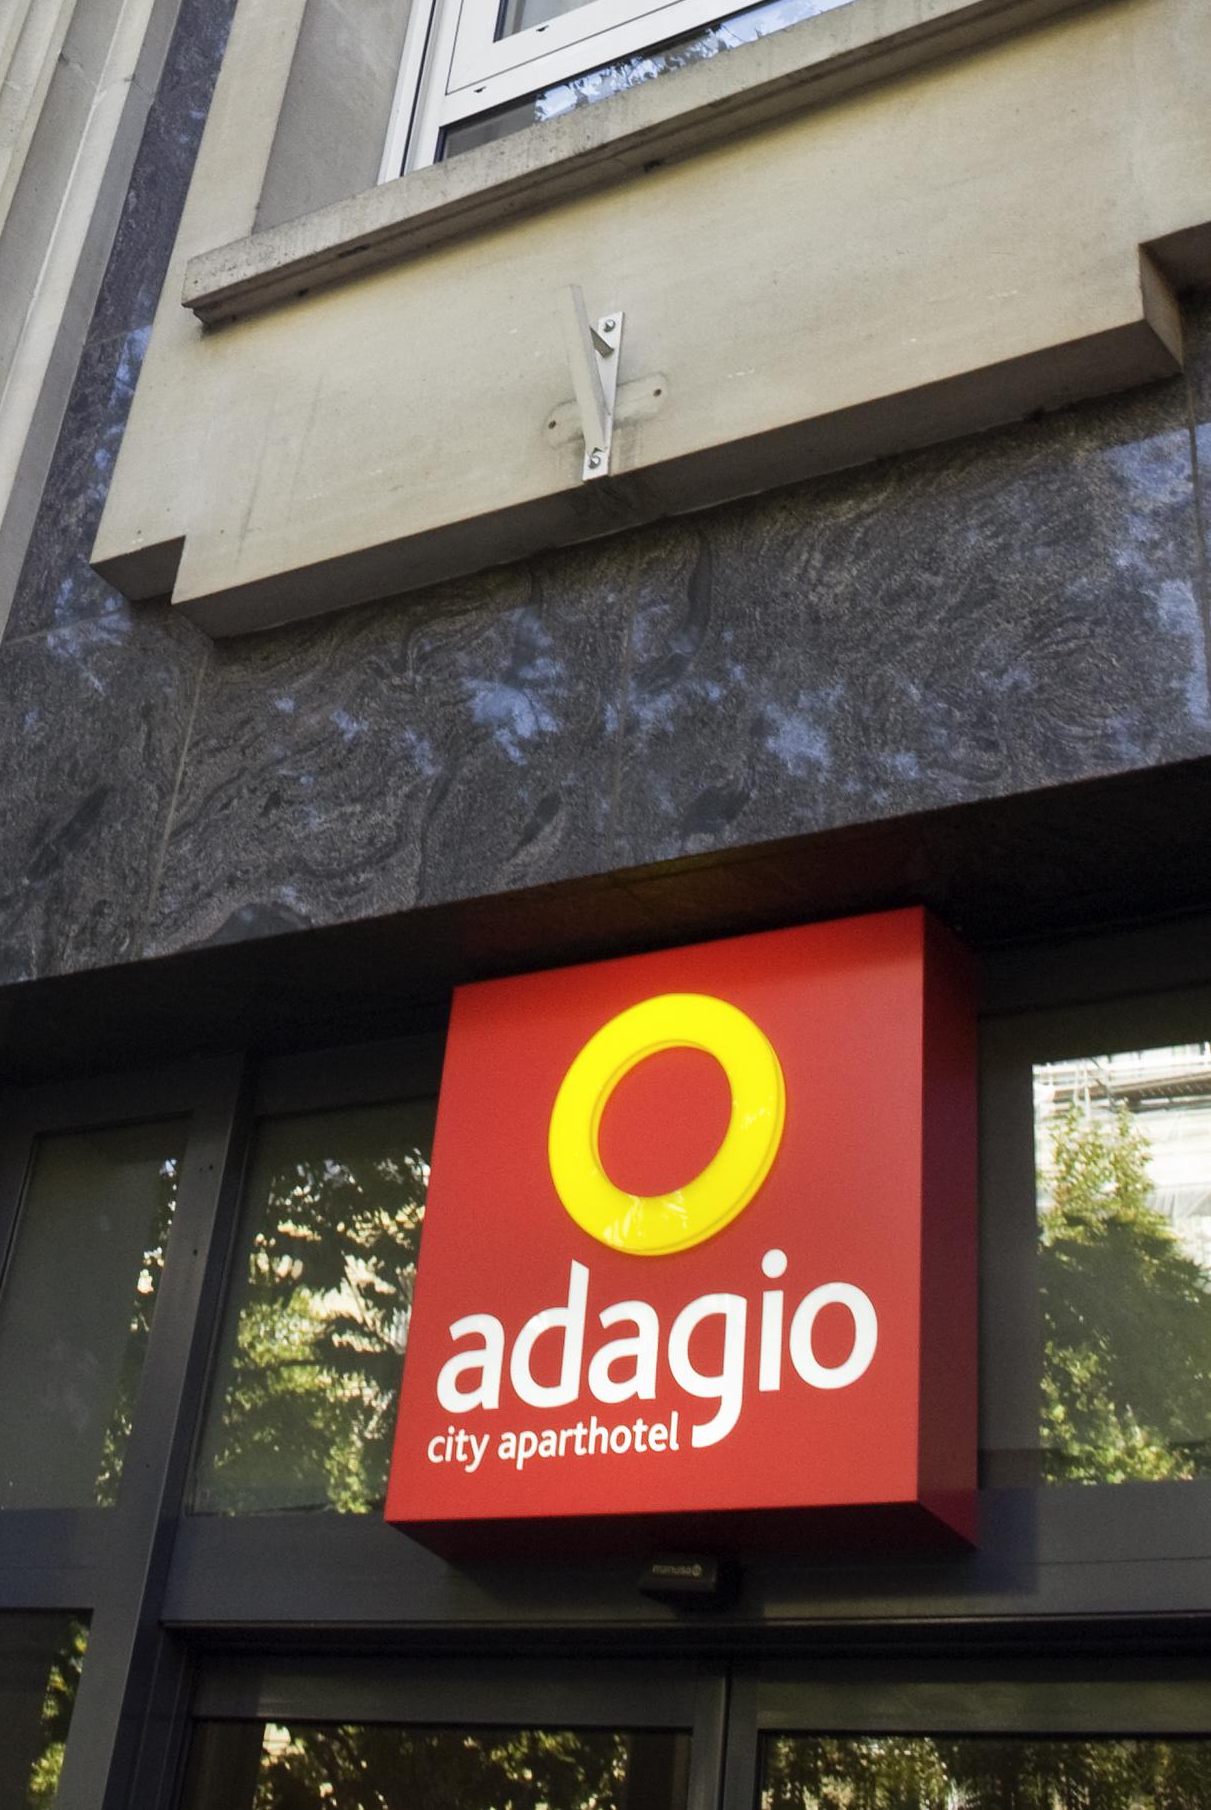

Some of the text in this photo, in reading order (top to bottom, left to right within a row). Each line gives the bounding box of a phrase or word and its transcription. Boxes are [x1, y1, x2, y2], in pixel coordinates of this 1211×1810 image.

[436, 1248, 879, 1449] adagio
[427, 1412, 680, 1473] city aparthotel
